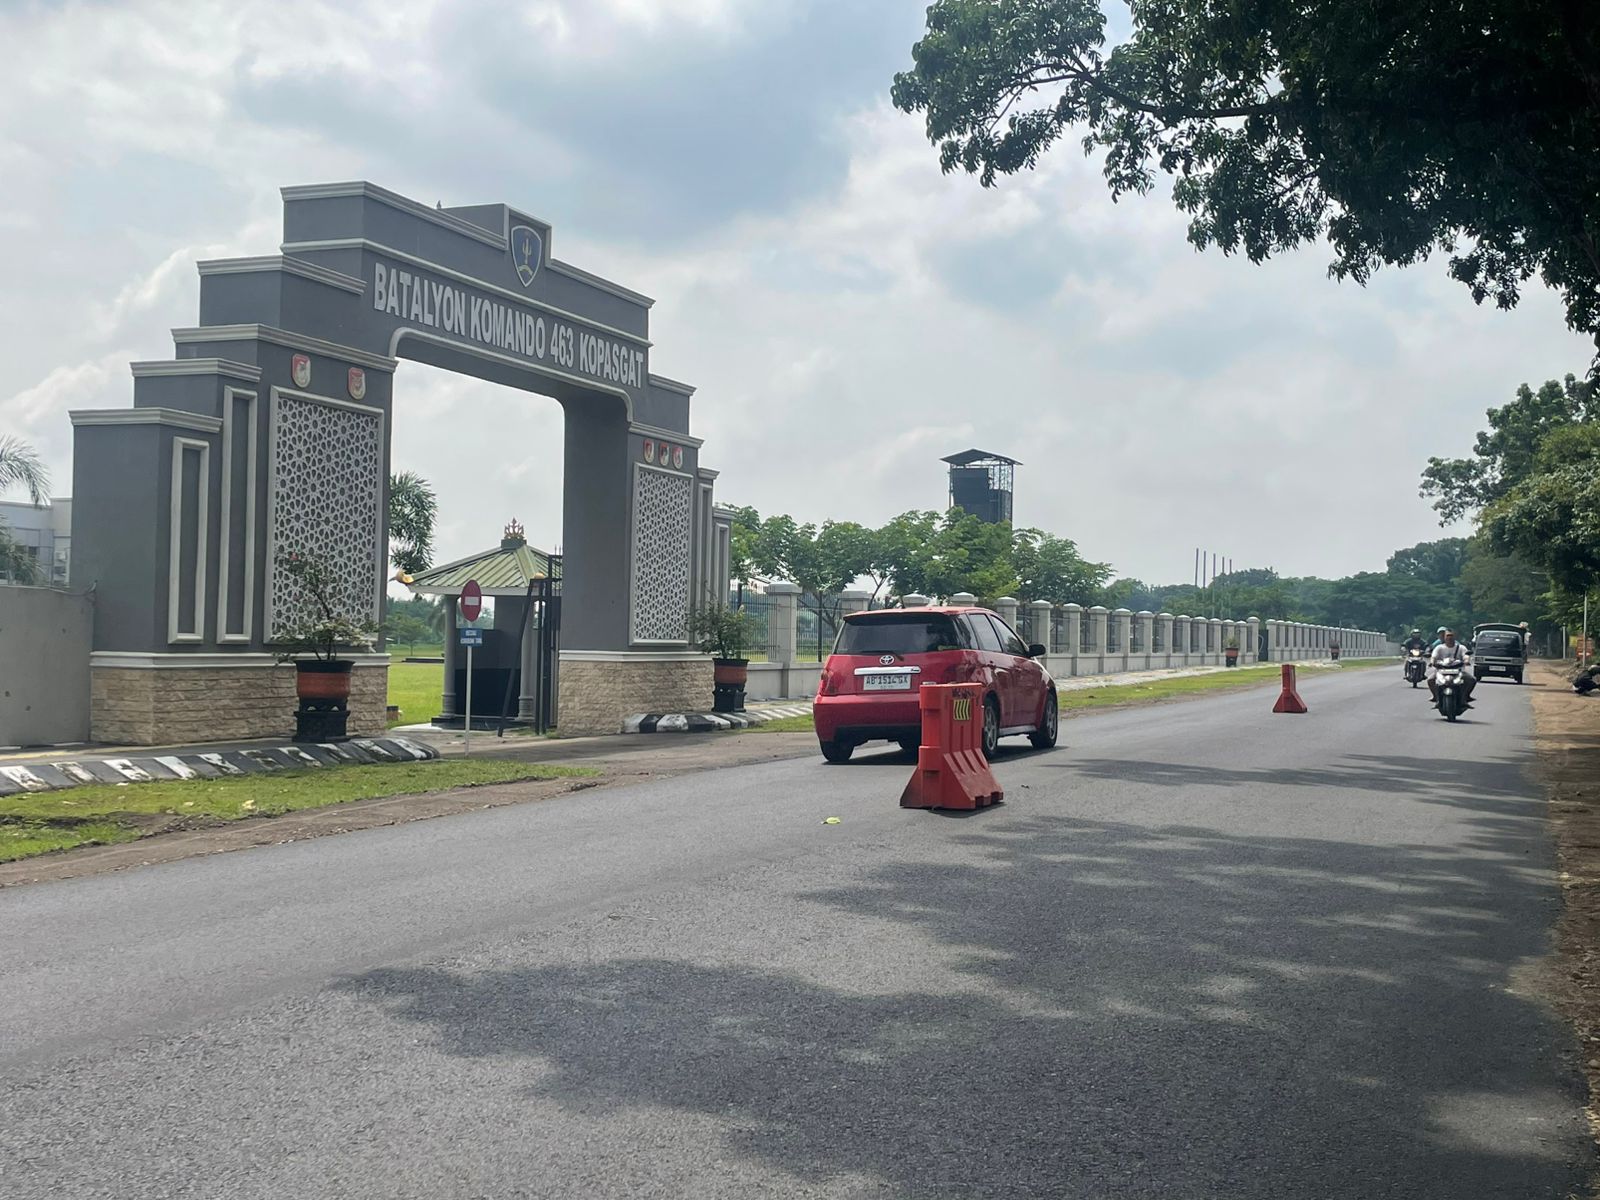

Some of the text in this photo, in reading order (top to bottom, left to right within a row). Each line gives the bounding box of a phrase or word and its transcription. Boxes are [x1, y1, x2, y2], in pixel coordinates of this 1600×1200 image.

[374, 263, 644, 388] BATALYON KOMANDO 463 KOPASGAT
